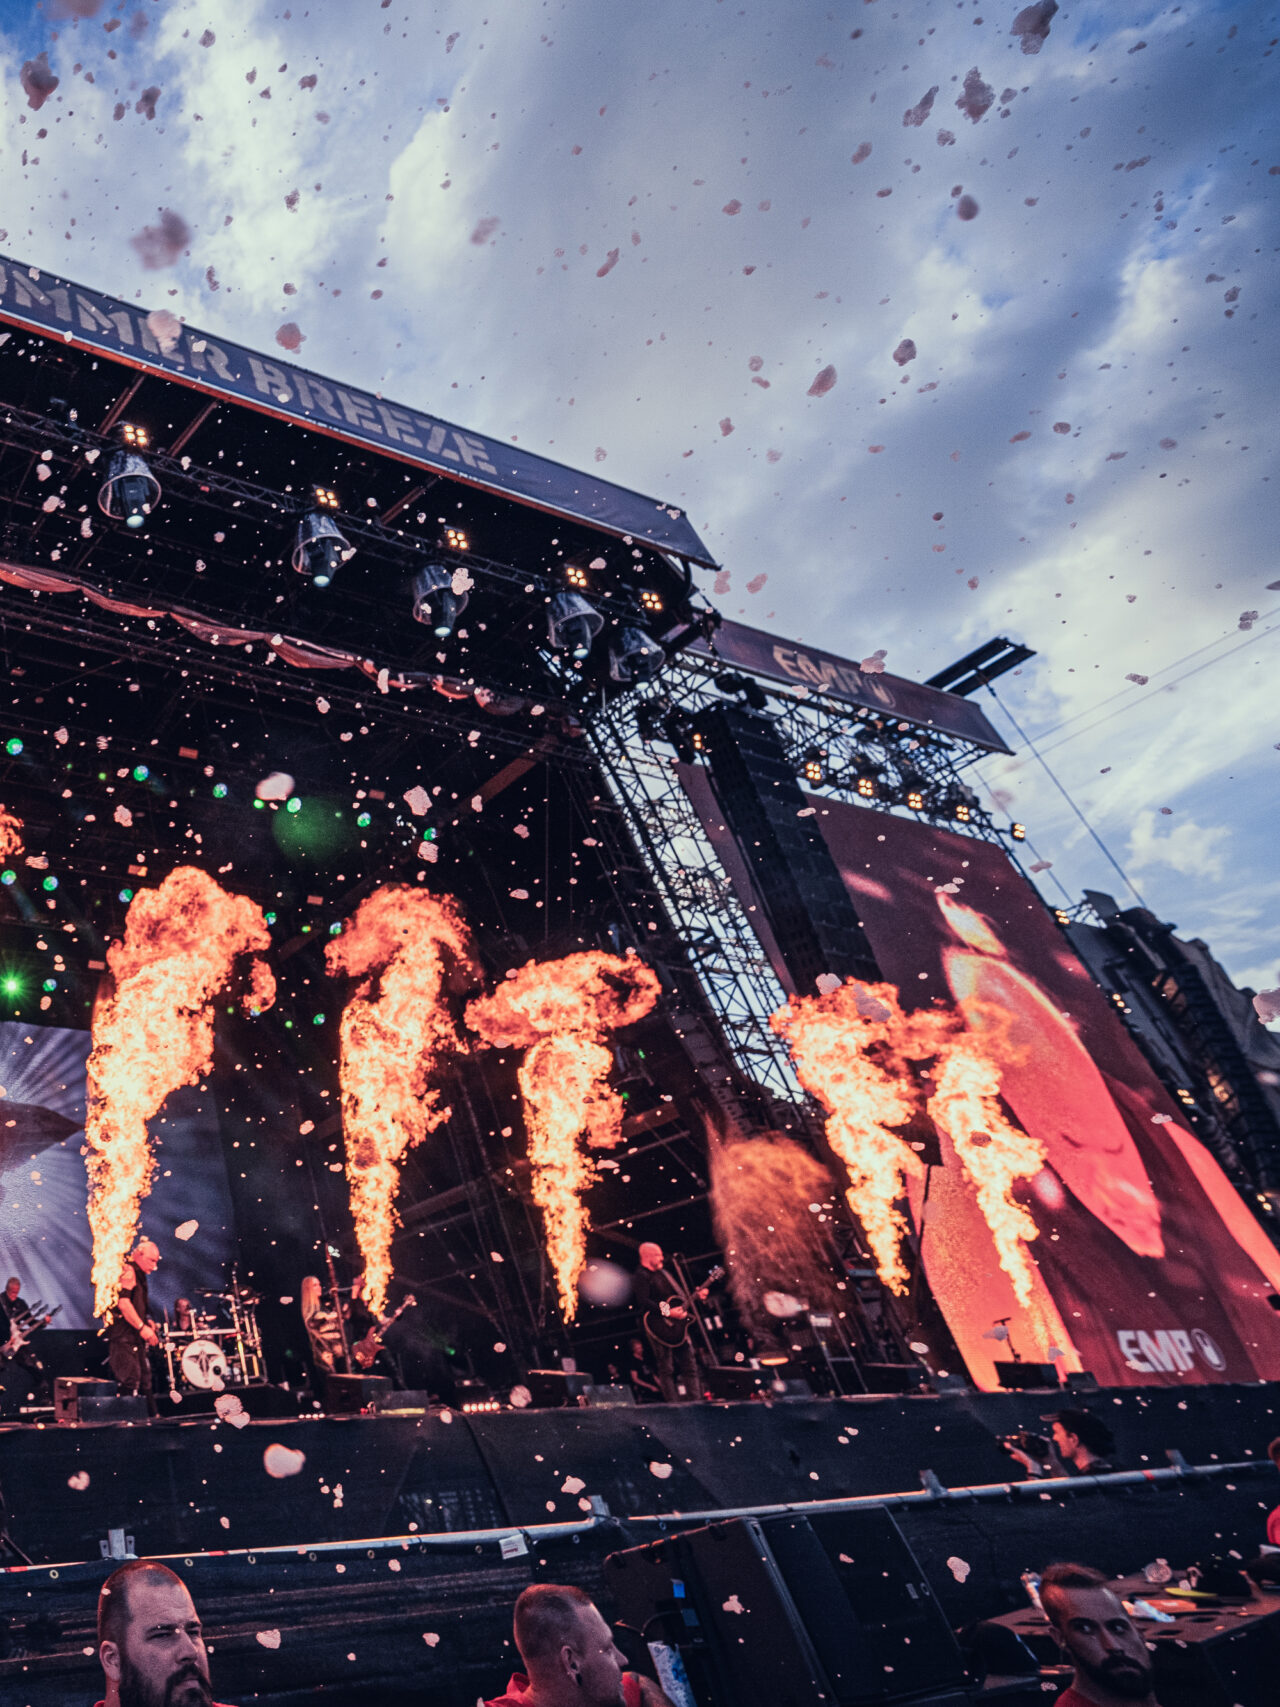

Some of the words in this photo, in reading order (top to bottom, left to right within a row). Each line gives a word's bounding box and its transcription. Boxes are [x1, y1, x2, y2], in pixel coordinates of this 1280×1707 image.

[247, 356, 498, 475] BREEZE
[772, 644, 863, 695] EMP
[1116, 1329, 1195, 1372] EMP
